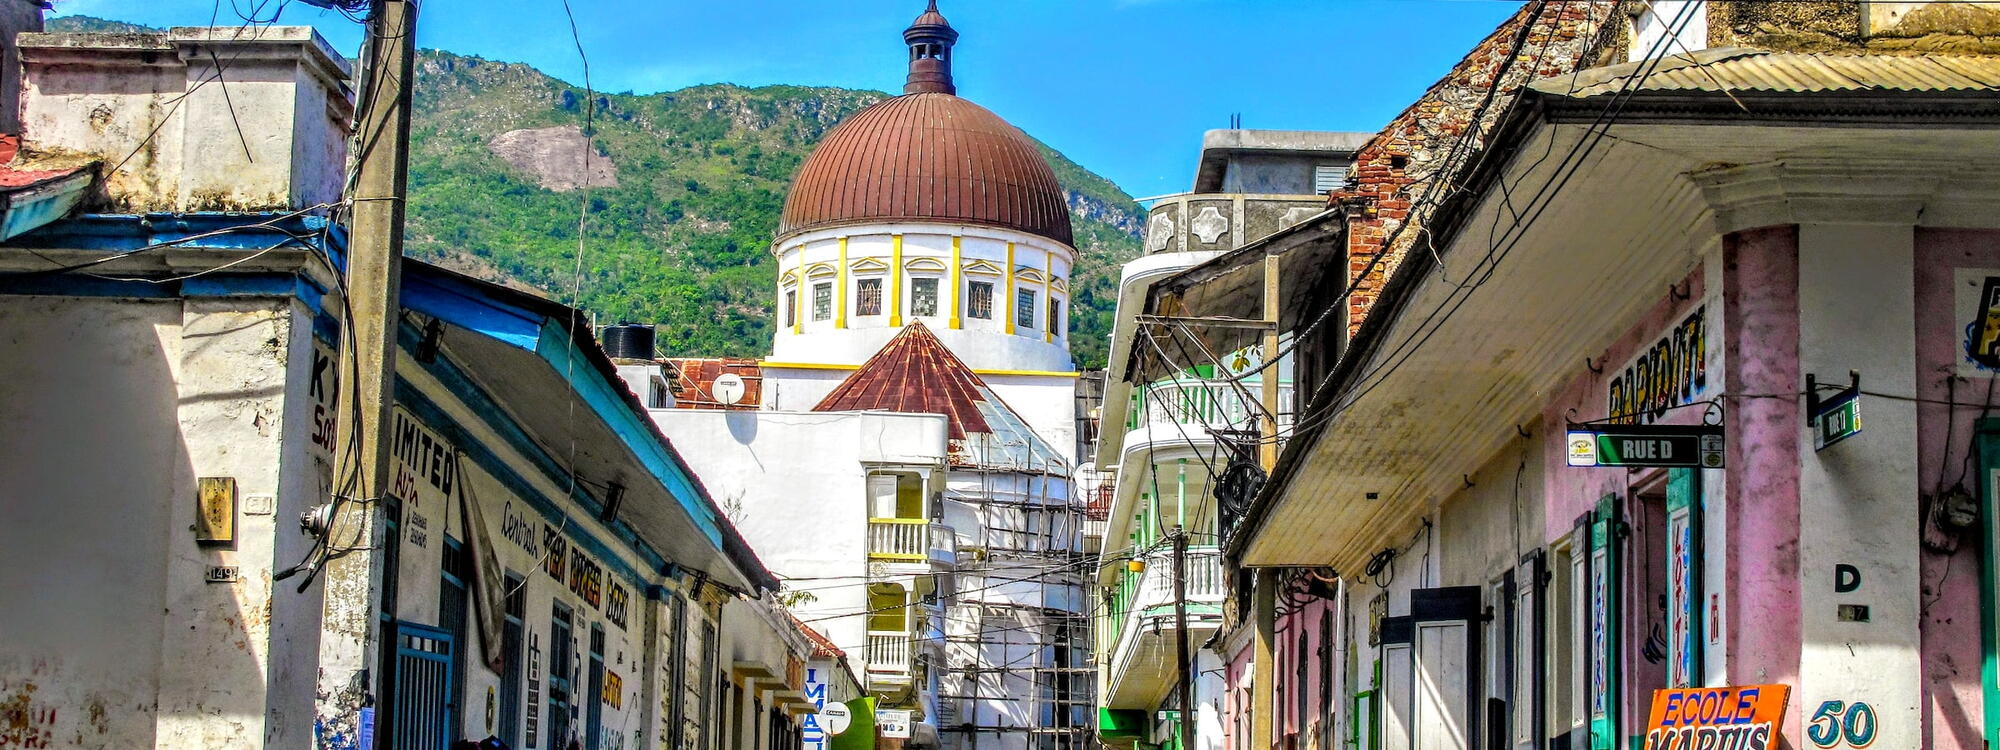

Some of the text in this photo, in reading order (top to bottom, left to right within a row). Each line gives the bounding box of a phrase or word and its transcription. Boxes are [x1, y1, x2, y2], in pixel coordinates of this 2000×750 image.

[394, 413, 454, 496] IMITED
[1622, 440, 1673, 459] RUE D
[1835, 564, 1861, 592] D
[1661, 688, 1759, 726] ECOLE
[1807, 700, 1878, 749] 50
